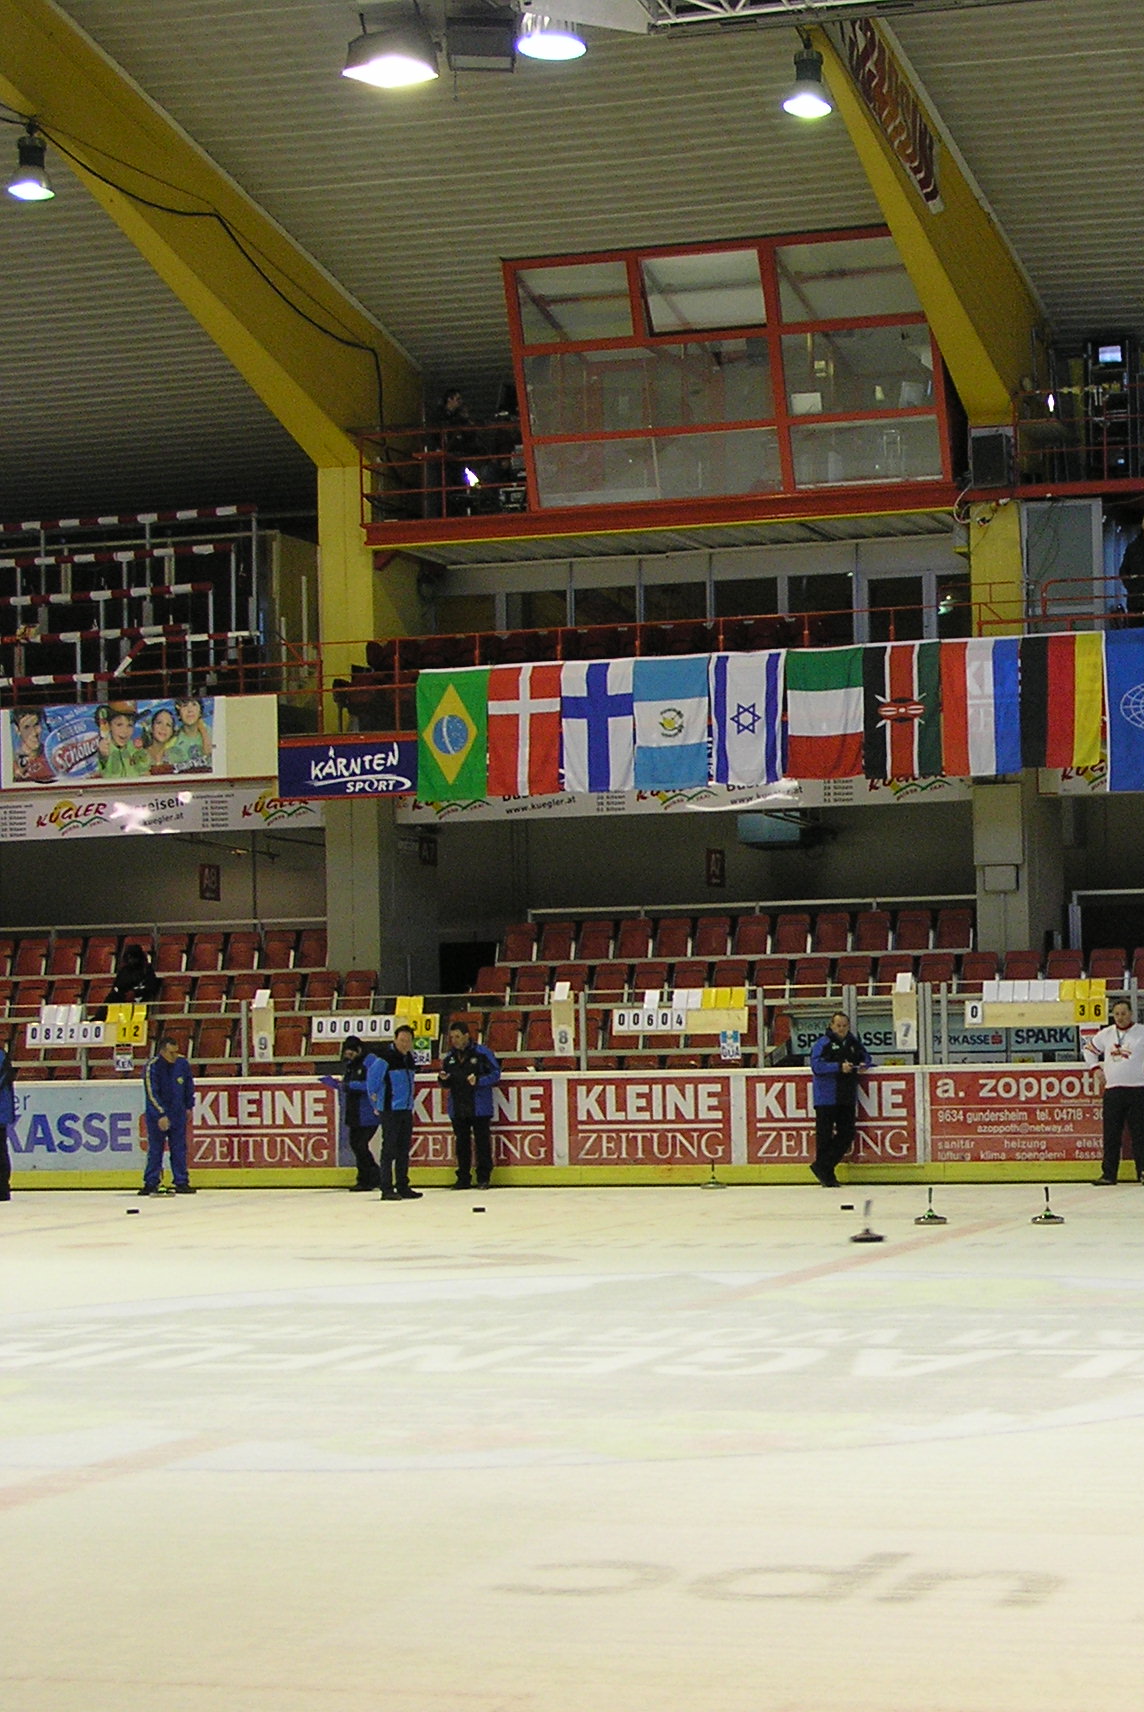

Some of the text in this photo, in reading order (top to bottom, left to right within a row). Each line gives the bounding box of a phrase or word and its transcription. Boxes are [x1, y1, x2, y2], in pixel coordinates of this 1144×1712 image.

[311, 742, 399, 780] KÄRNTEN
[346, 779, 396, 792] SPORT
[36, 801, 107, 828] KÜGLER
[505, 796, 577, 815] www.kuegler.at
[192, 1090, 328, 1126] KLEINE
[577, 1083, 723, 1121] KLEINE
[938, 1110, 964, 1122] 9634
[966, 1109, 1028, 1124] gundersheim
[1036, 1109, 1051, 1121] tel.
[1054, 1108, 1083, 1121] 04718
[192, 1135, 329, 1164] ZEITUNG
[578, 1132, 725, 1160] ZEITUNG
[937, 1139, 975, 1150] sanitär
[1004, 1138, 1047, 1152] heizung
